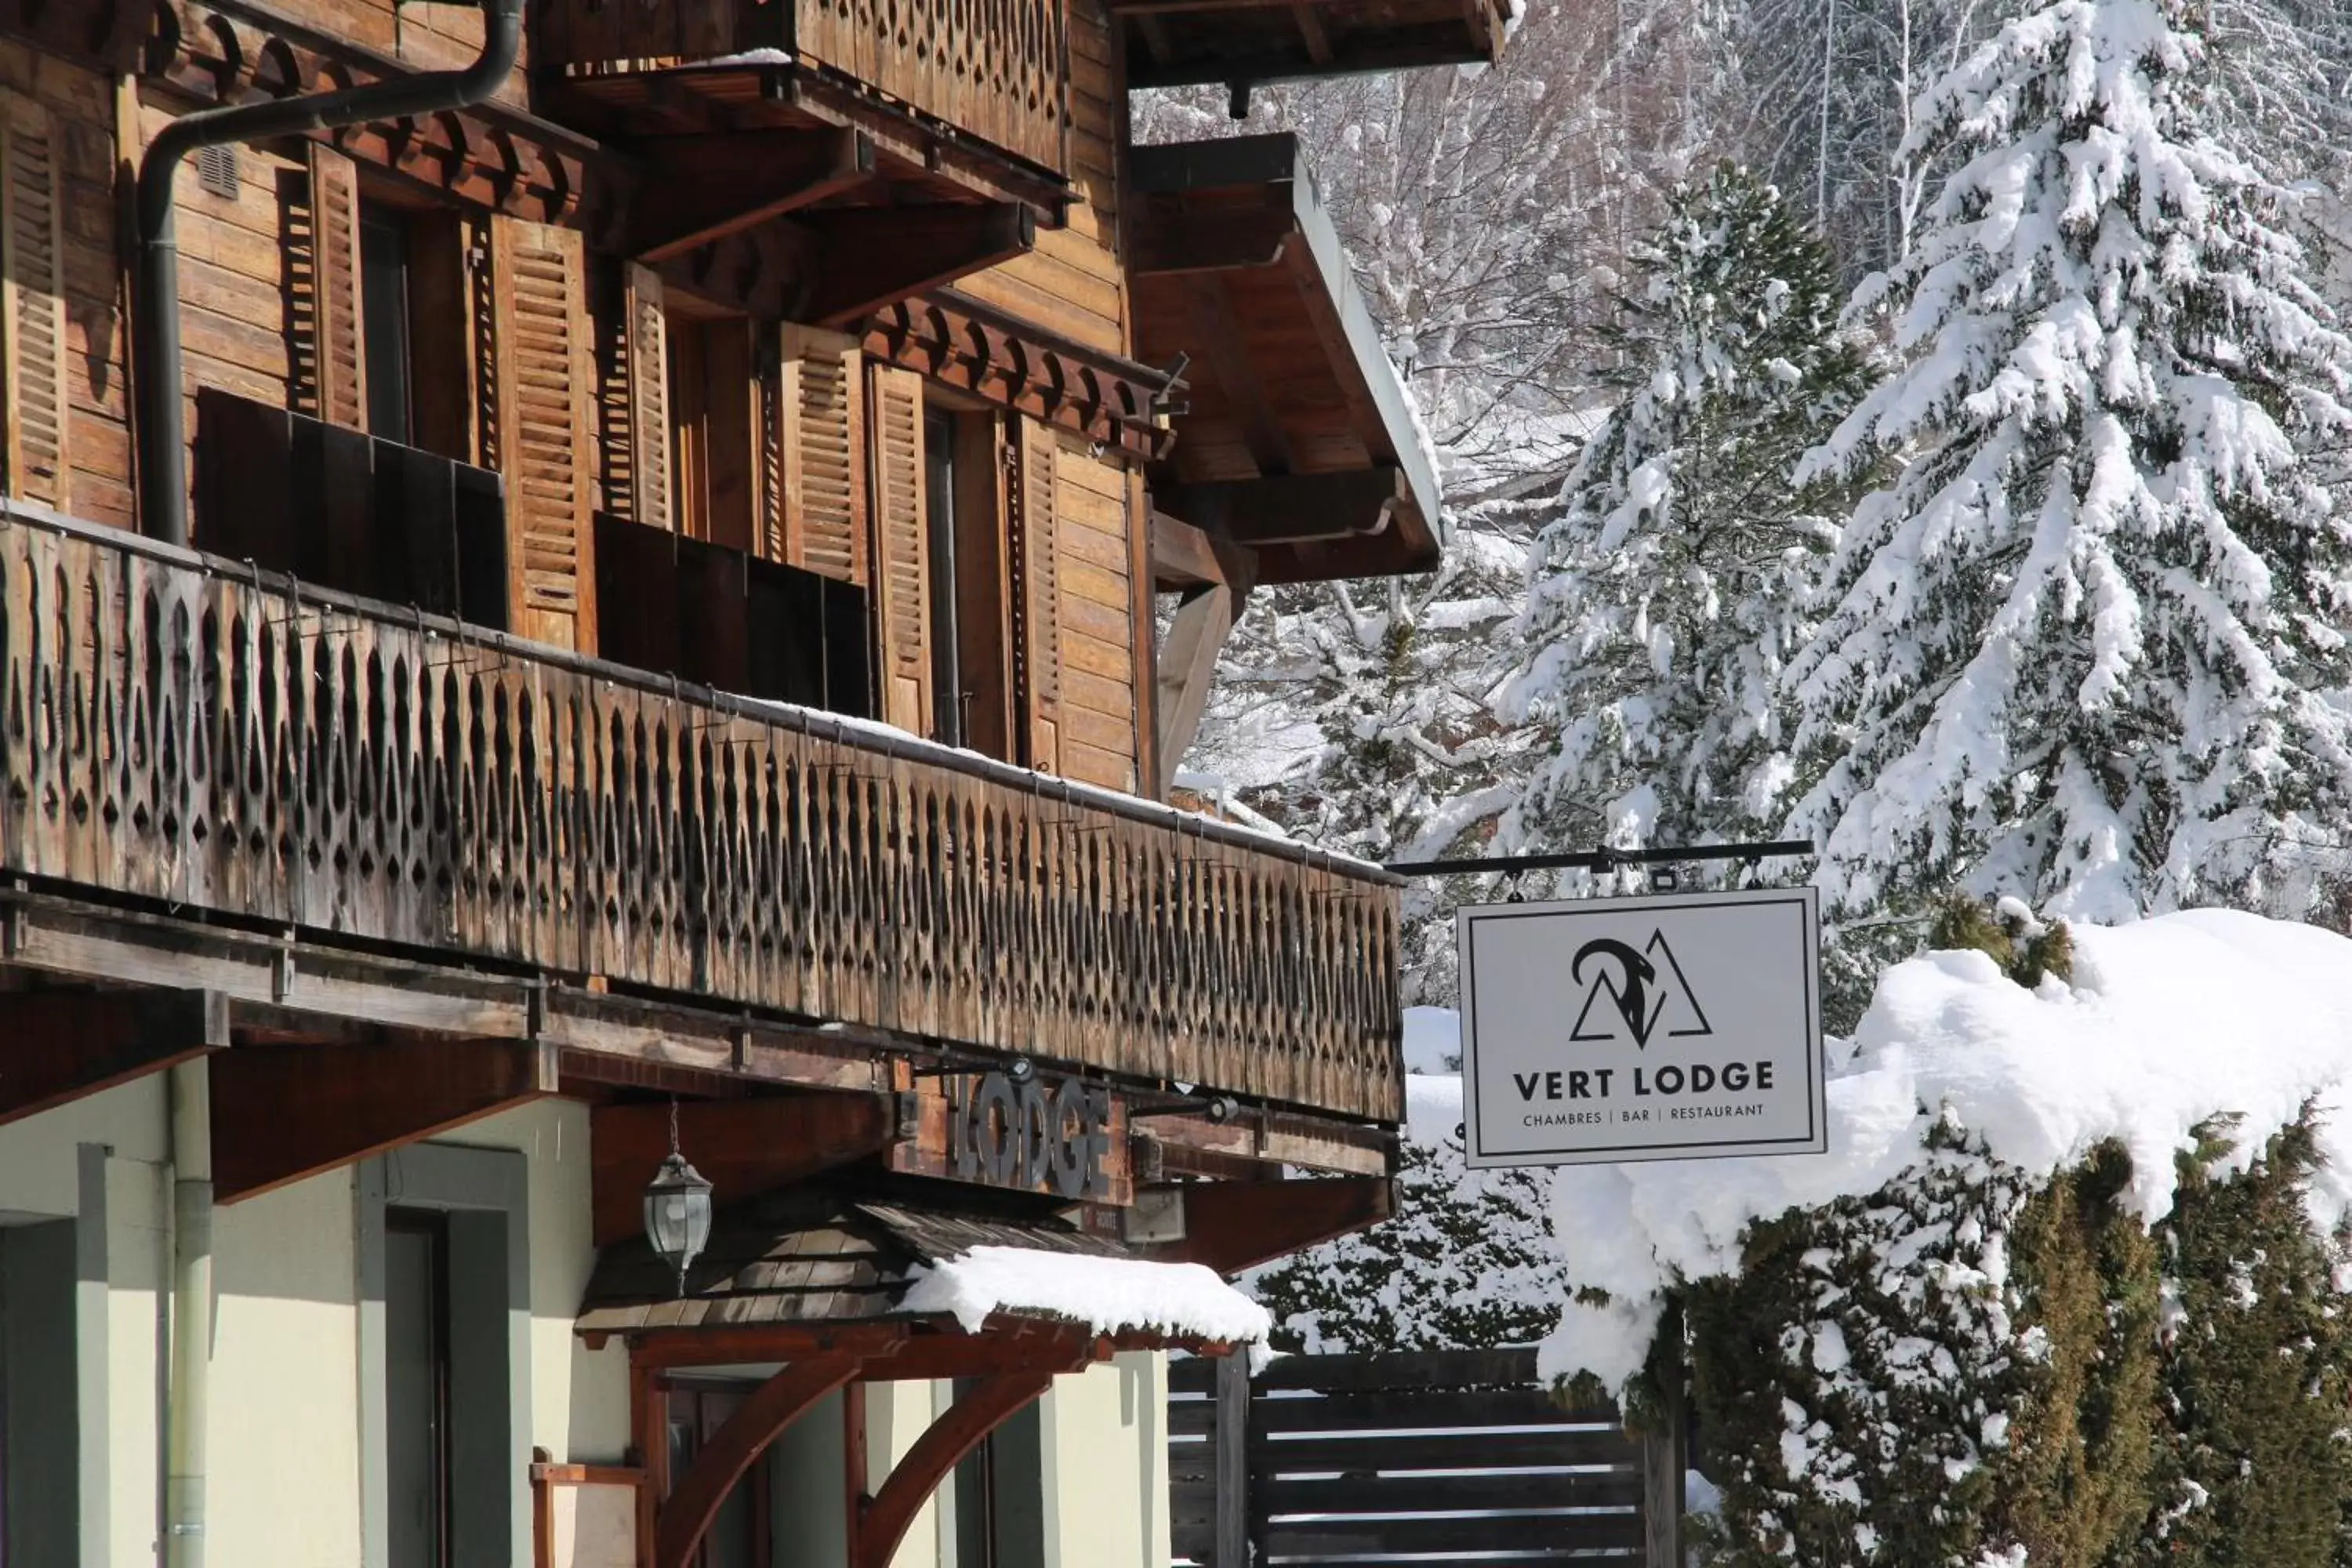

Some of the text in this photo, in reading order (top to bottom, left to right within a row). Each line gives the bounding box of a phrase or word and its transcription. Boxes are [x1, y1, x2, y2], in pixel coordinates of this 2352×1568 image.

[1512, 1061, 1773, 1102] VERT LODGE
[956, 1071, 1109, 1200] LODGE
[1523, 1103, 1763, 1127] CHAMBRES BAR RESTAURANT
